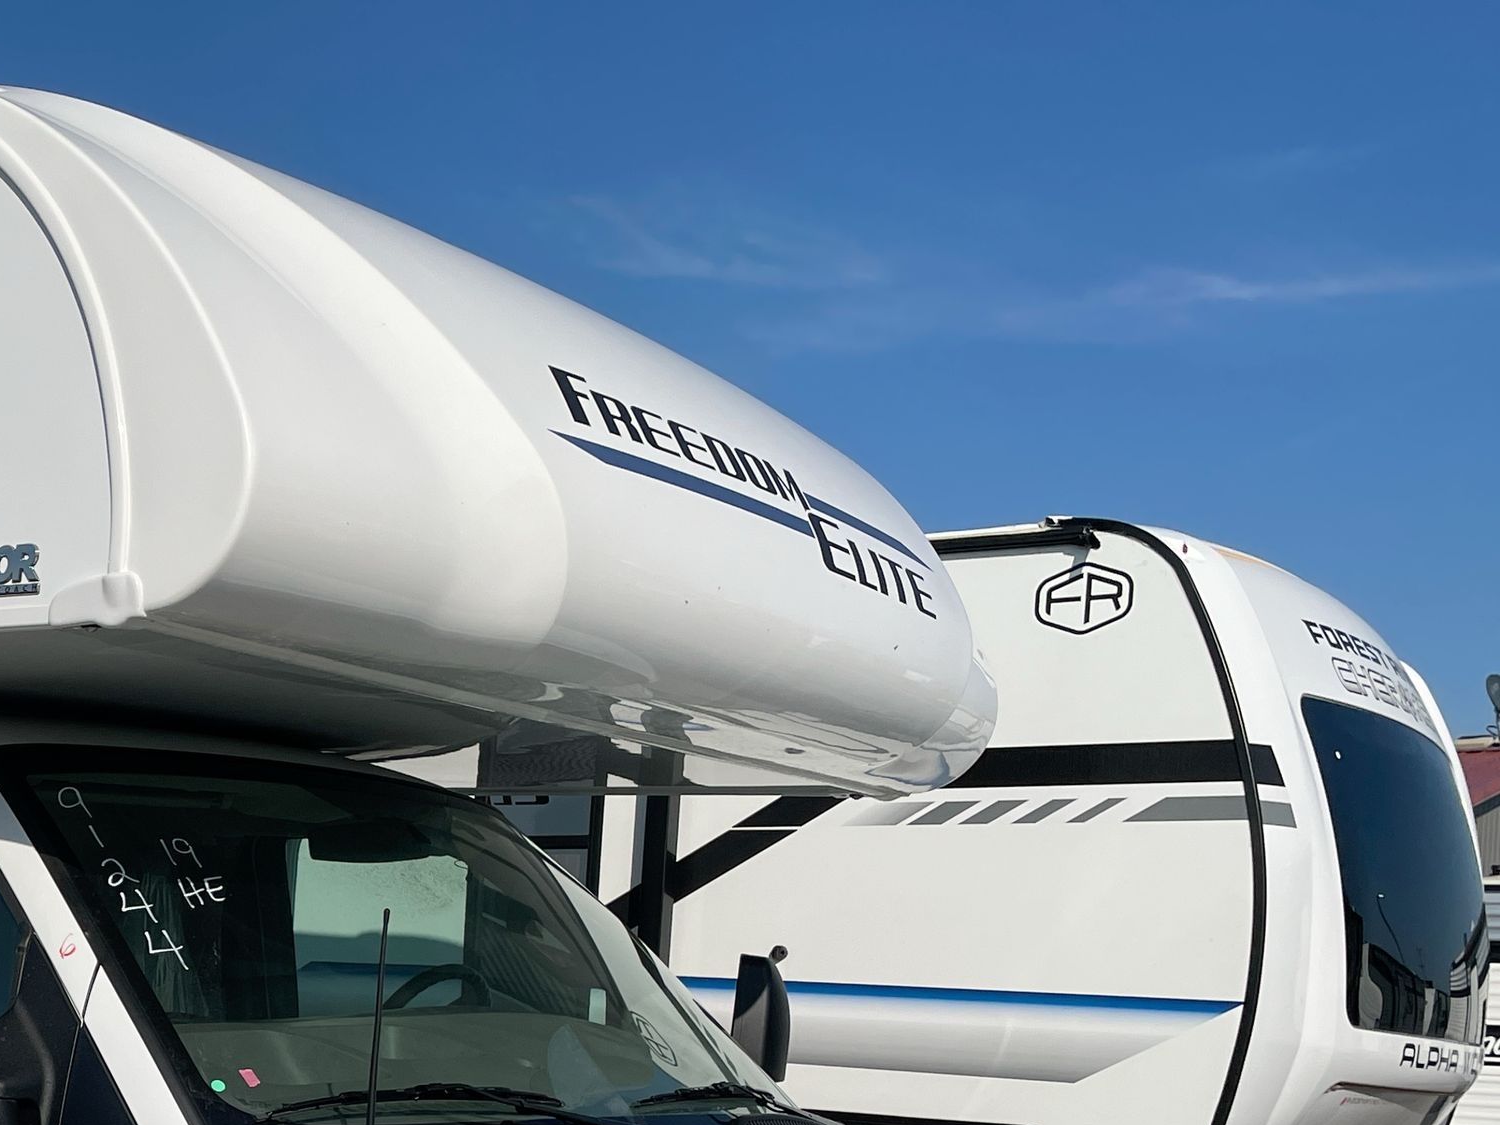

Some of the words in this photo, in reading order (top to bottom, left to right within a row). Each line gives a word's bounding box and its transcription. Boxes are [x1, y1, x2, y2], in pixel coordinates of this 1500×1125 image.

[547, 365, 812, 511] FREEDOM
[807, 511, 938, 620] ELITE
[1301, 619, 1386, 666] FOREST
[159, 838, 203, 868] 19
[1399, 1043, 1460, 1073] ALPHA
